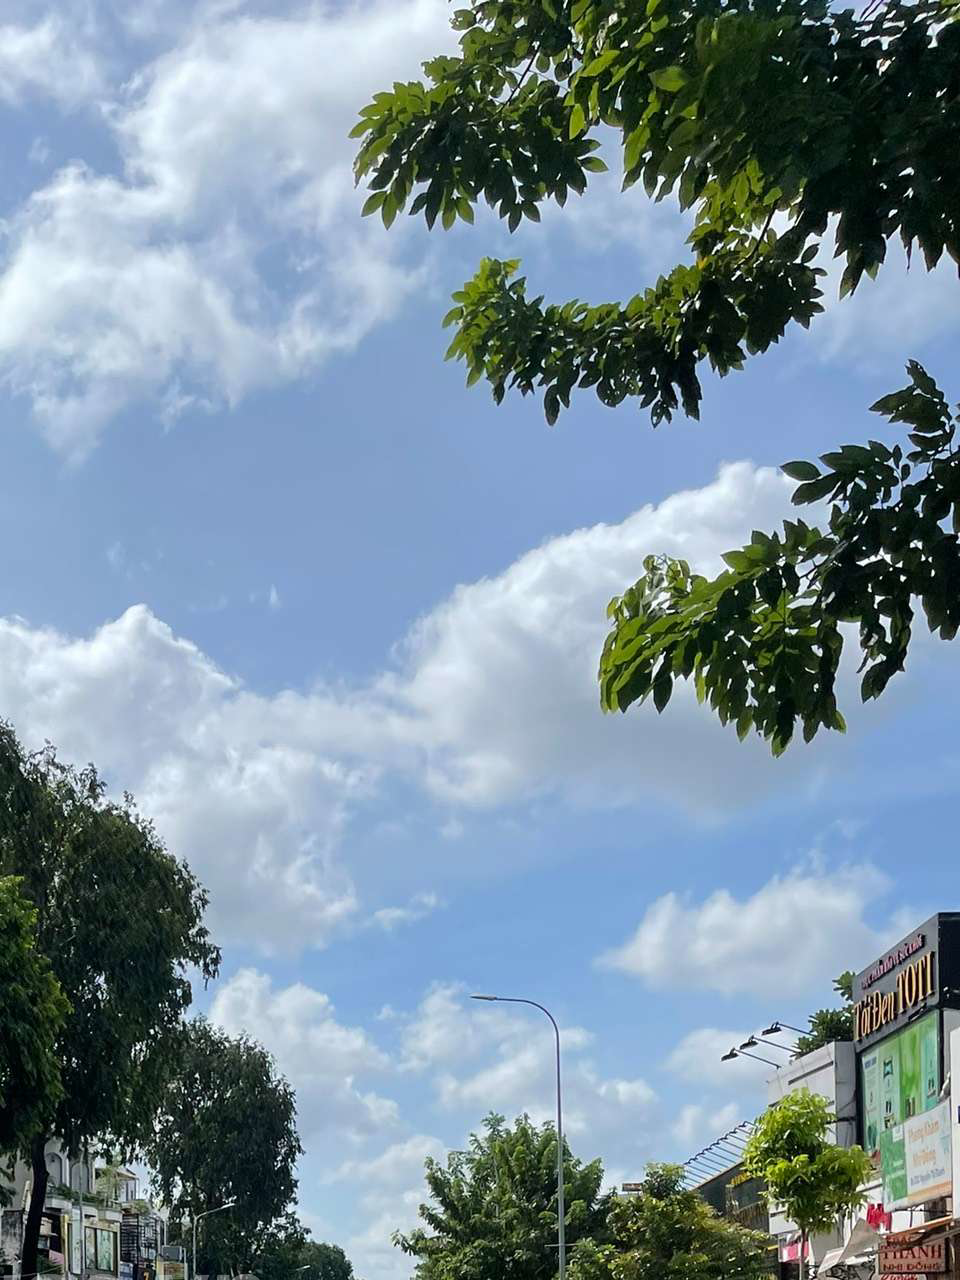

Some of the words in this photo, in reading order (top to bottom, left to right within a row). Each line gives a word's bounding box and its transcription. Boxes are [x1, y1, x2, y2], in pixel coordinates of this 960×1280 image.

[872, 991, 895, 1031] Đen
[896, 951, 933, 1014] TOTI
[883, 1245, 942, 1260] THANH
